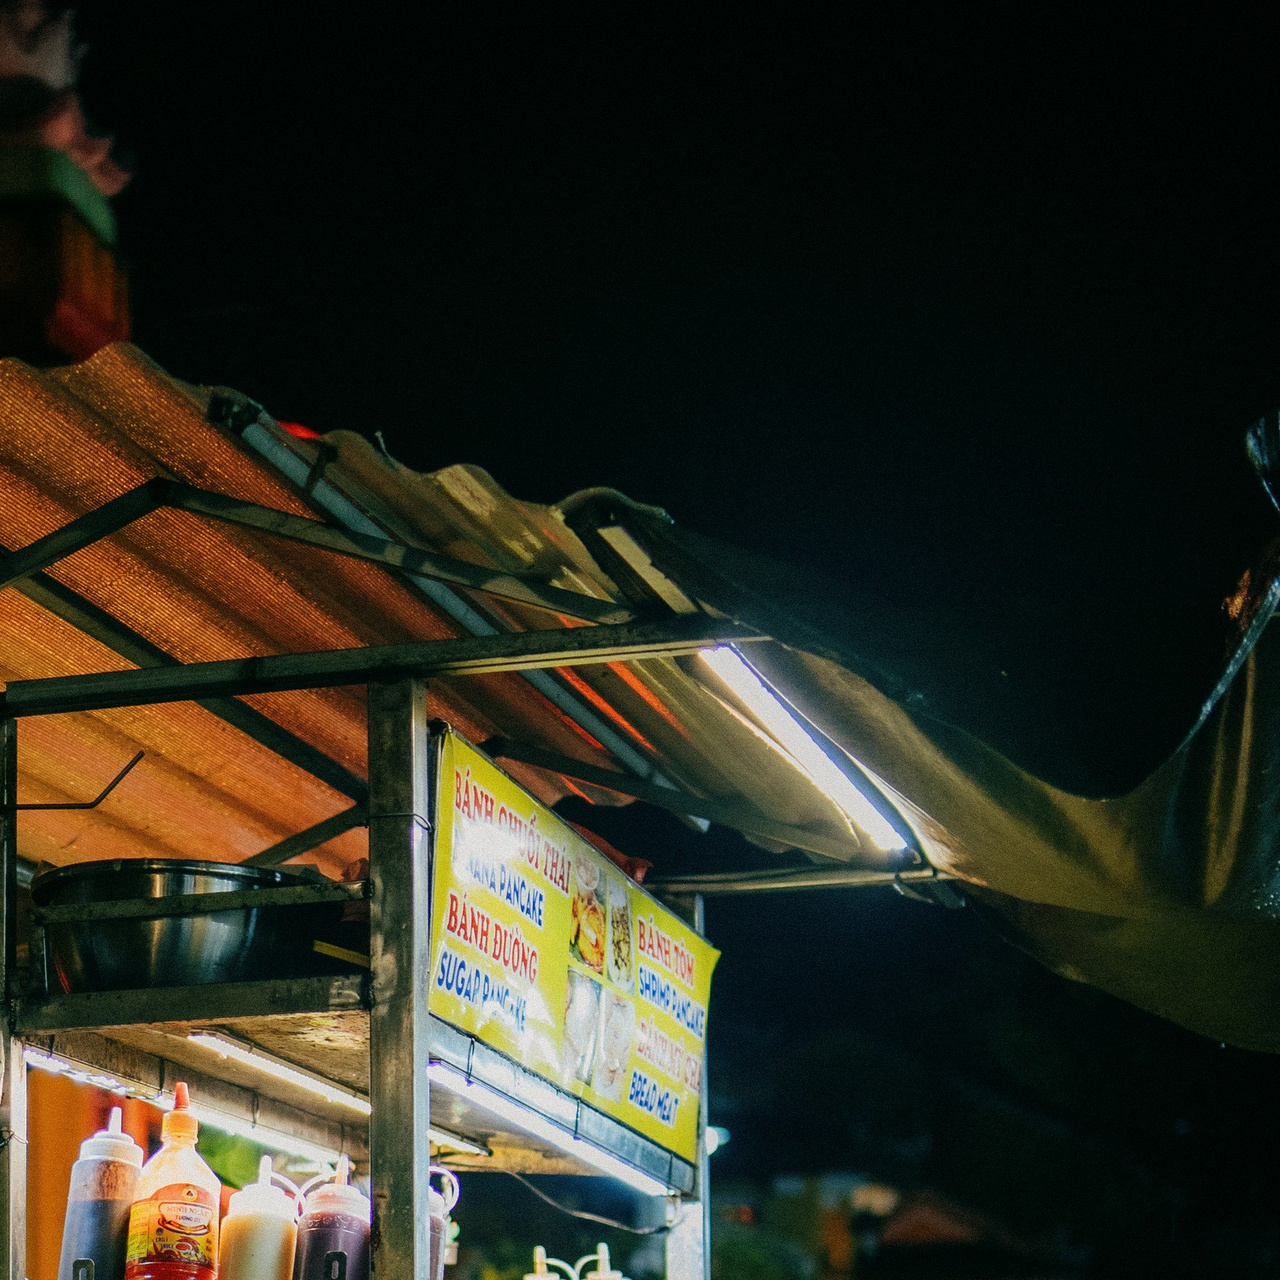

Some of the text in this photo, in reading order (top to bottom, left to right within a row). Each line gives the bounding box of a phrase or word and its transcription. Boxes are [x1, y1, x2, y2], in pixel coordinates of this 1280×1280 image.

[456, 769, 494, 822] BÁNH
[499, 862, 543, 927] PANCAKE
[447, 892, 538, 985] BÁNH ĐƯỜNG
[638, 917, 694, 987] BÁNH TÔM
[639, 966, 705, 1039] SHRIMP PANCAKE
[629, 1071, 679, 1125] BREAD MEAT
